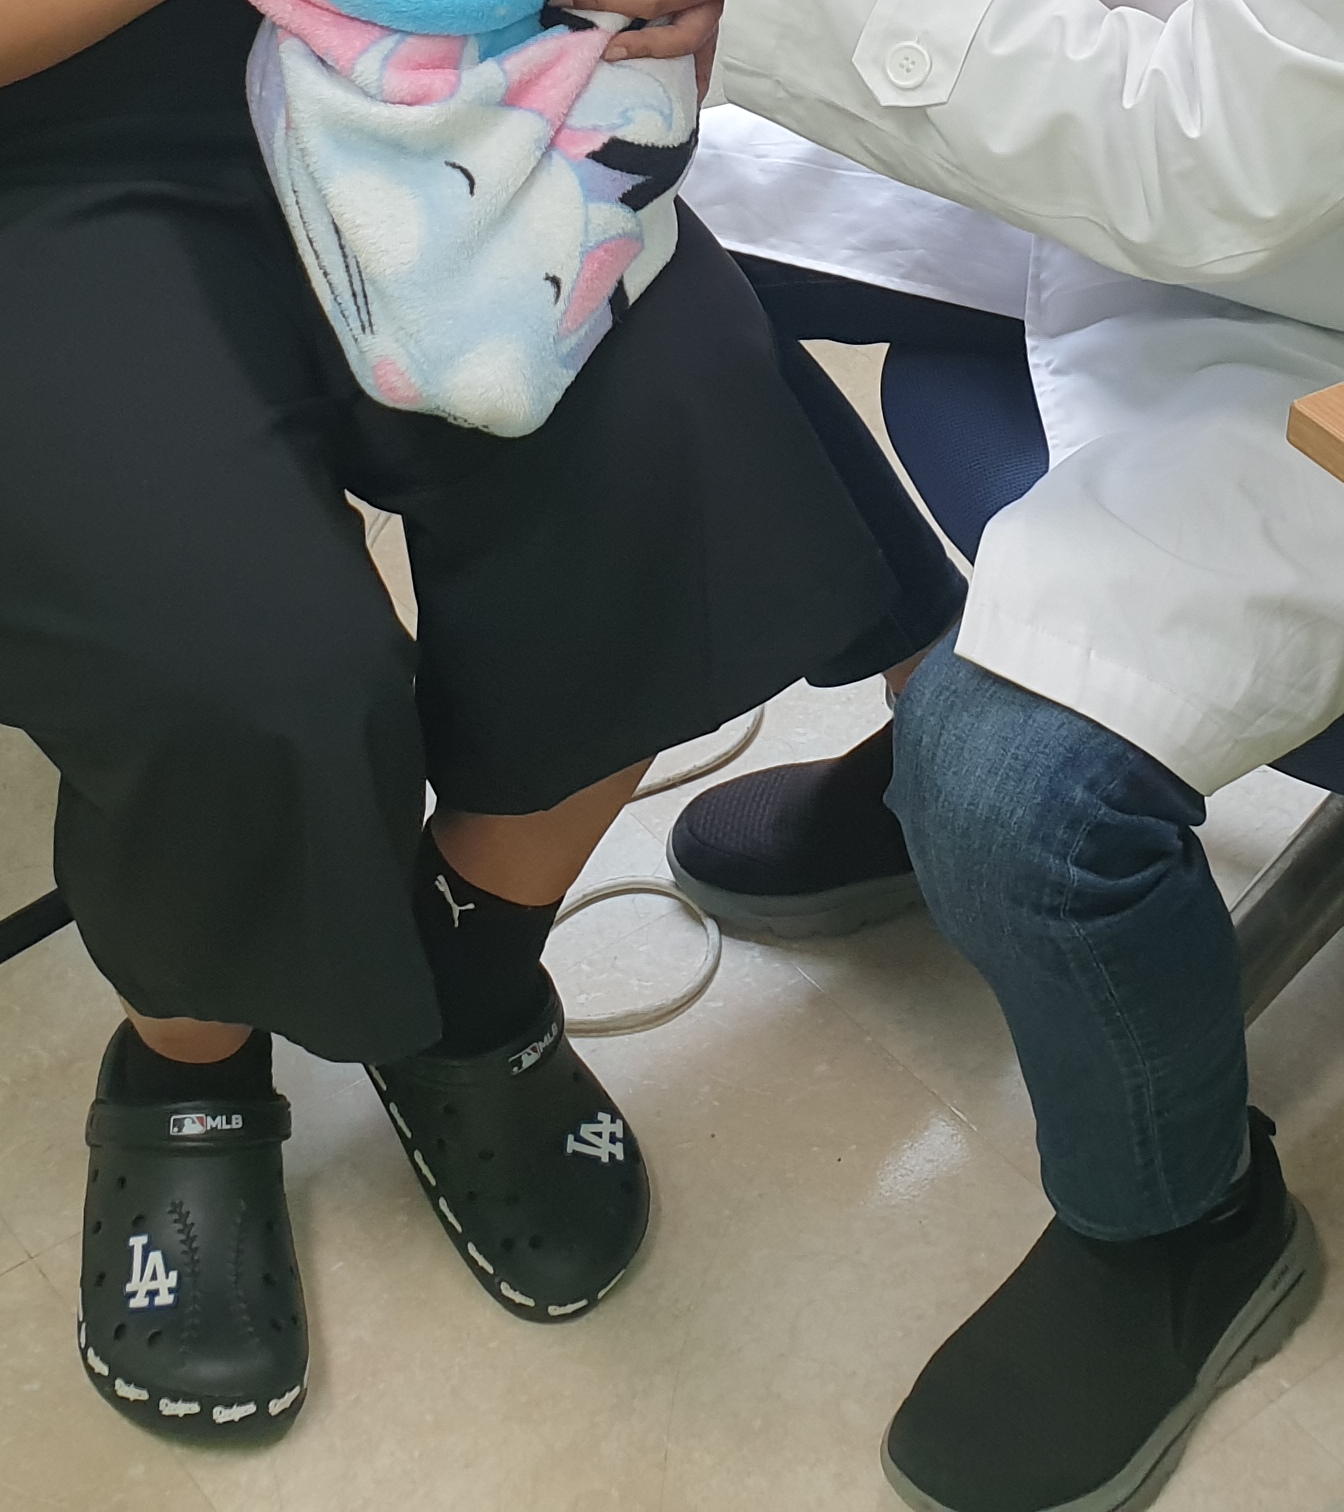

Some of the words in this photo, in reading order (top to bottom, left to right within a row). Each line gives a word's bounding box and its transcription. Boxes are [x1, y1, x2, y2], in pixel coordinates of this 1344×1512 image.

[206, 1113, 243, 1131] MLB
[566, 1111, 624, 1163] LA
[125, 1233, 178, 1309] LA
